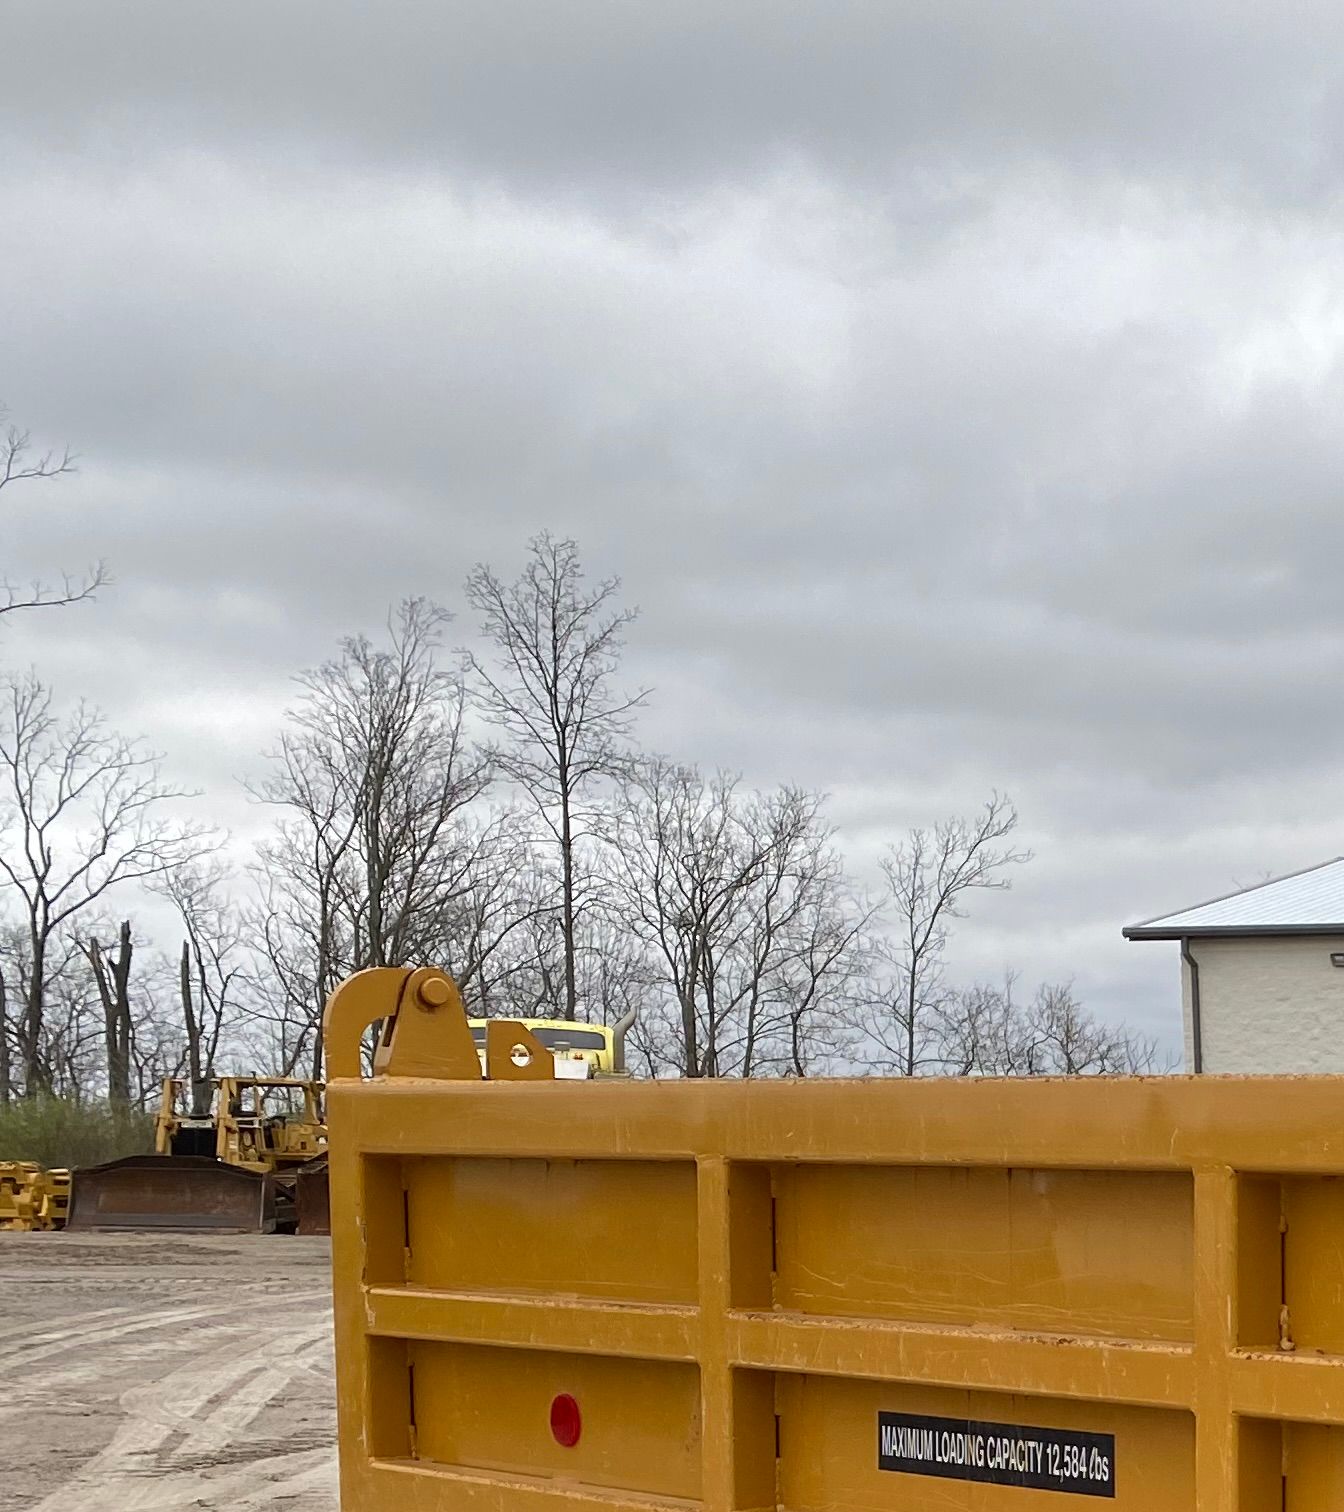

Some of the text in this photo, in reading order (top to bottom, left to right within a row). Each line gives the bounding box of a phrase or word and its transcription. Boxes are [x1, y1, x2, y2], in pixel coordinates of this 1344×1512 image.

[881, 1425, 933, 1461] MAXIMUM
[935, 1430, 984, 1467] LOADING
[986, 1436, 1042, 1474] CAPACITY
[1046, 1443, 1087, 1483] 12,584
